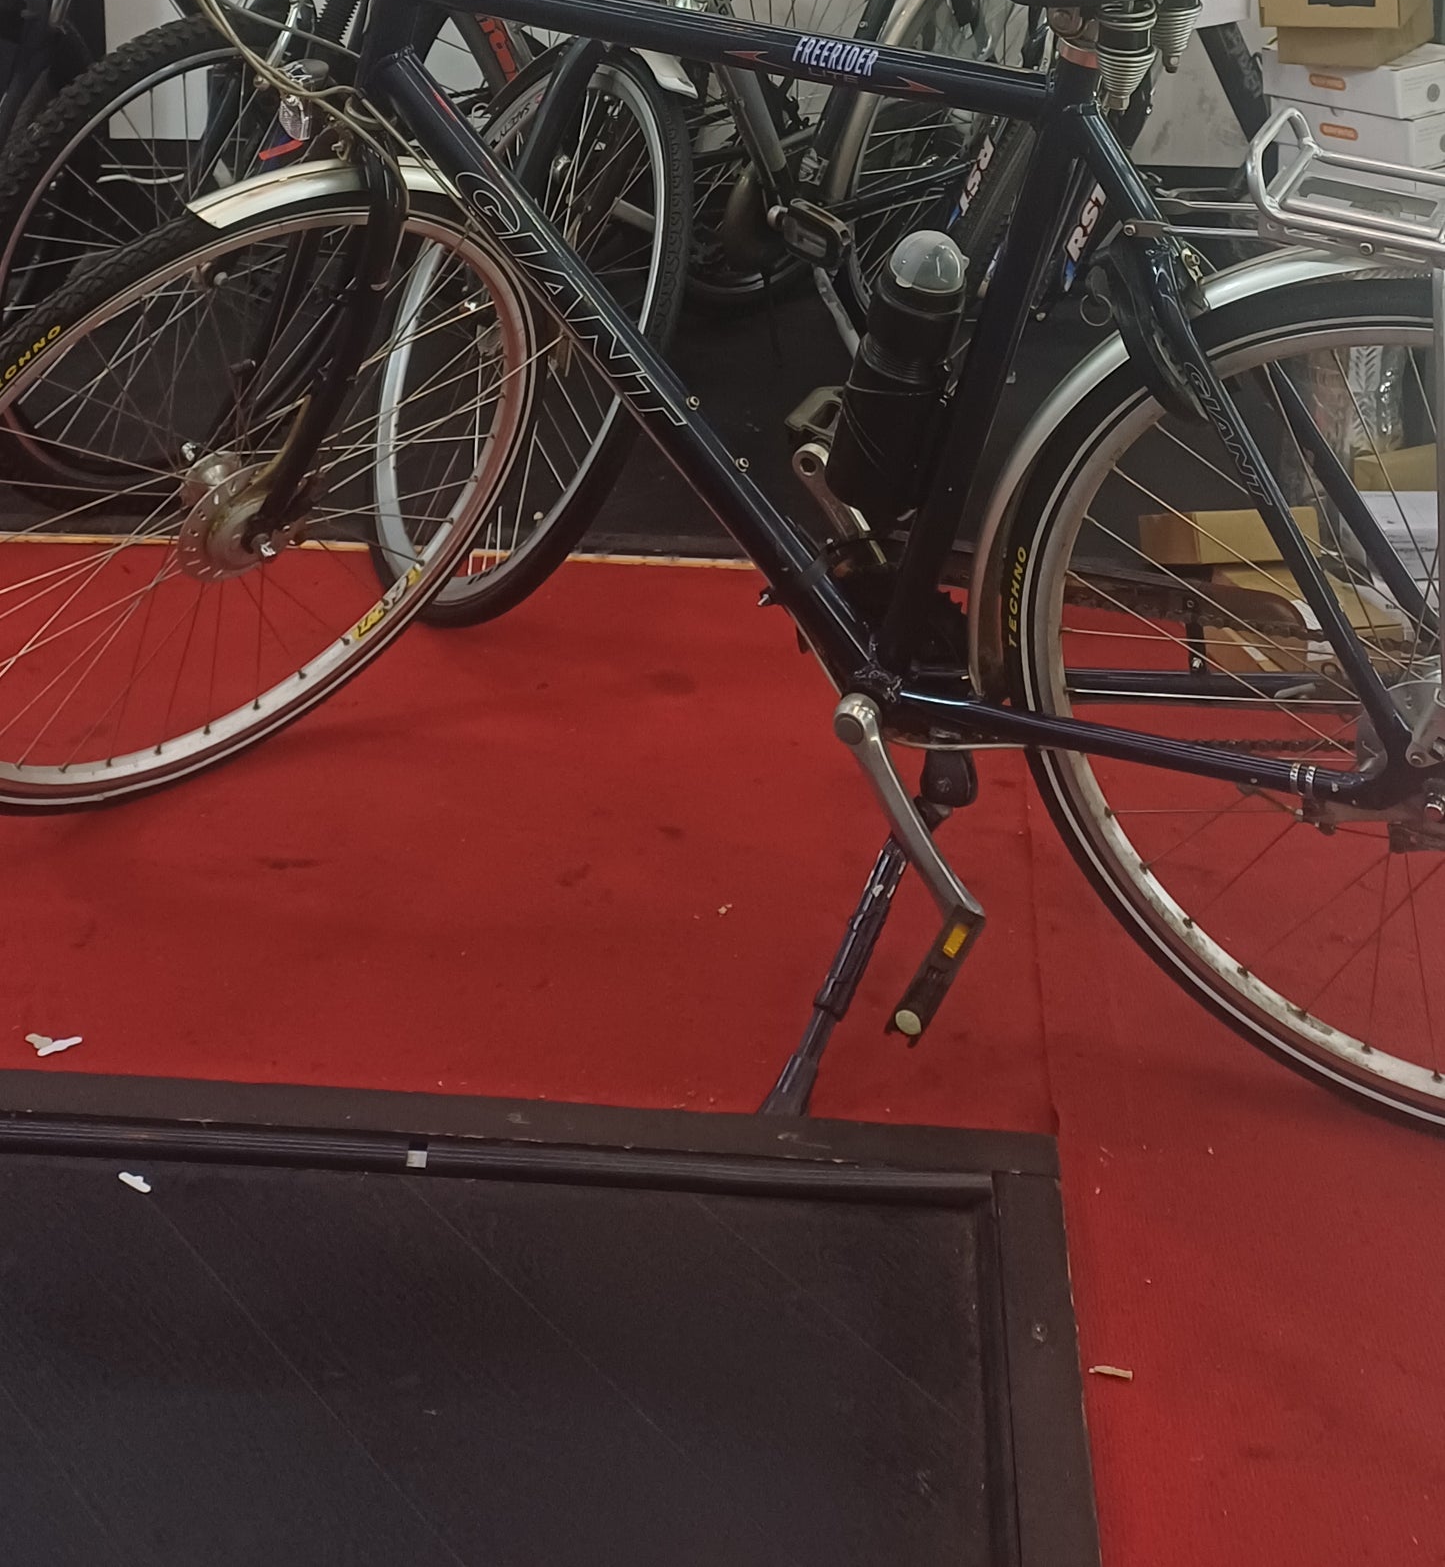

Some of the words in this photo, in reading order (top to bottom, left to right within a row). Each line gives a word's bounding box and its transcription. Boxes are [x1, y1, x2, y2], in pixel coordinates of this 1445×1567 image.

[792, 36, 880, 77] FREERIDER
[1064, 182, 1107, 263] RST
[455, 171, 688, 426] GIANT
[0, 325, 61, 388] CHNO
[1183, 361, 1274, 507] GIANT
[1008, 546, 1027, 649] TECHNO
